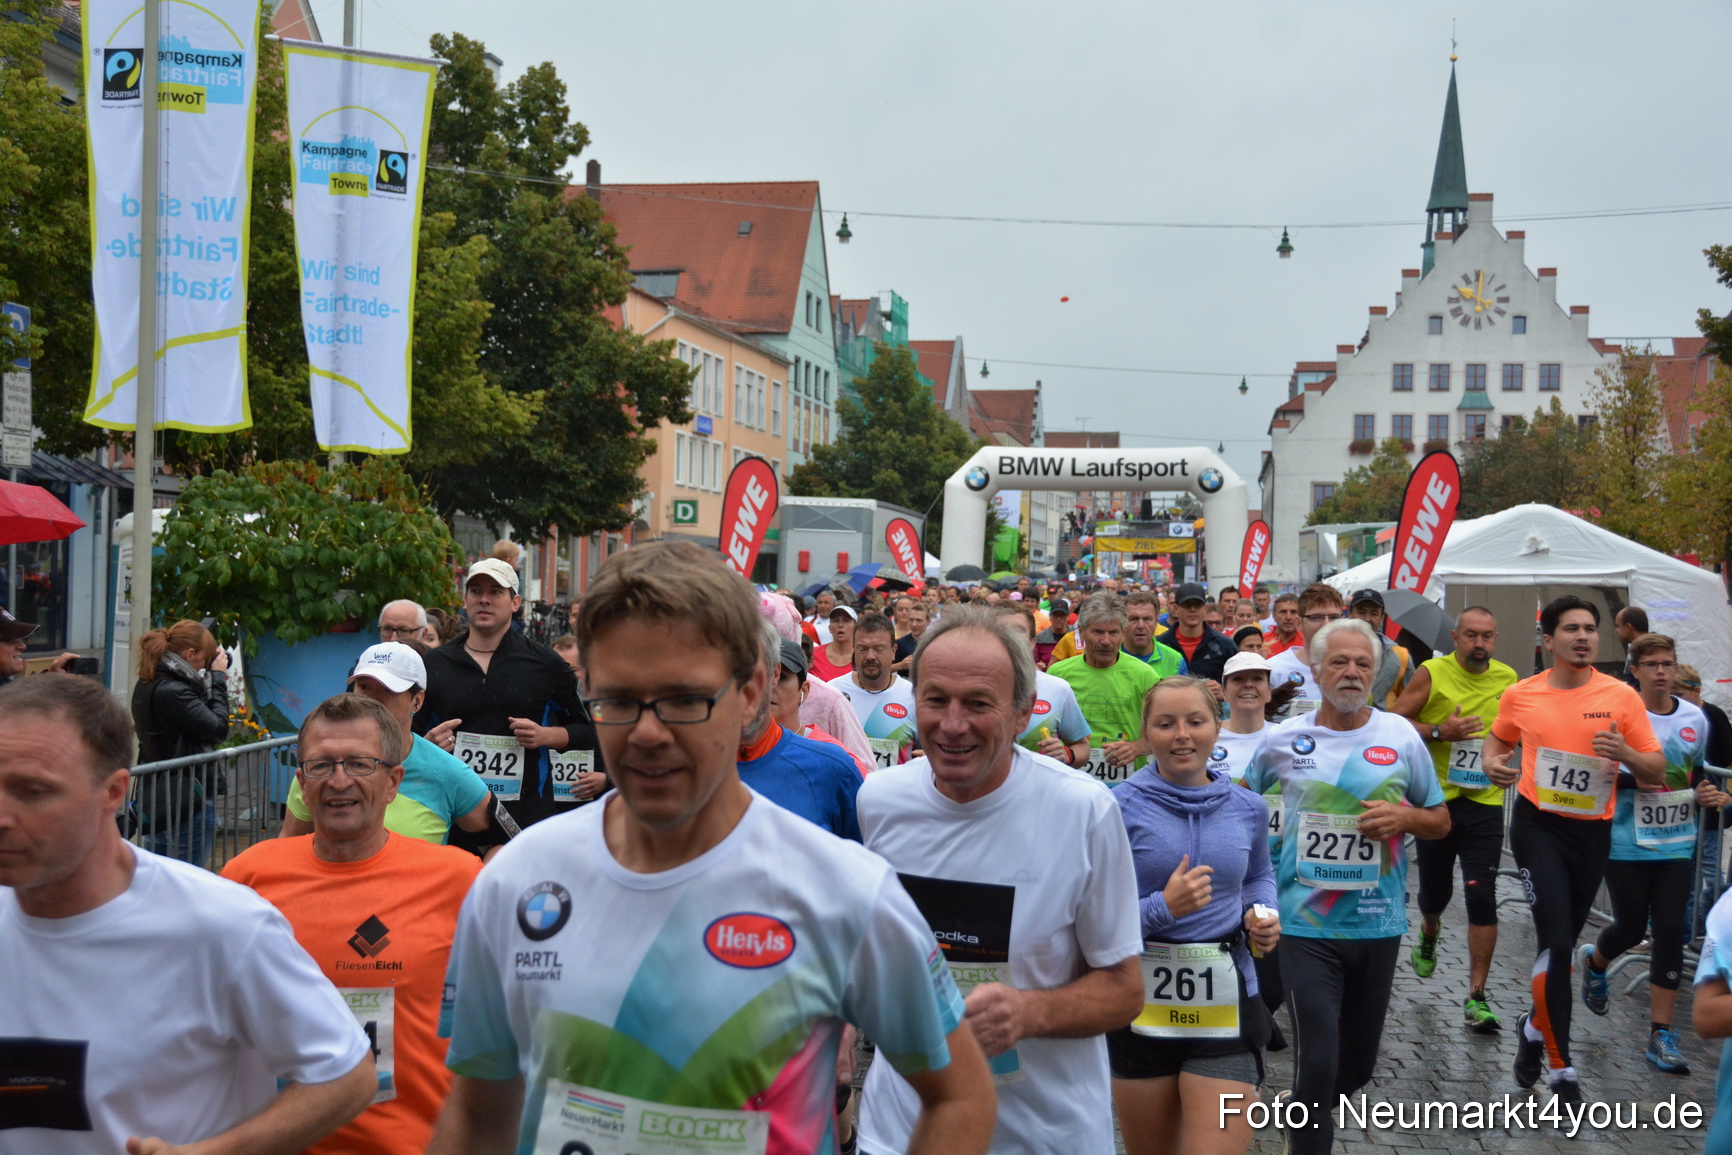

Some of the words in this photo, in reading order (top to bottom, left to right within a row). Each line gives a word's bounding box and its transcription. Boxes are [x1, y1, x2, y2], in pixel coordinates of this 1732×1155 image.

[302, 142, 368, 158] Kampagne
[302, 154, 373, 175] Fairtrade
[331, 178, 368, 191] Towns
[301, 259, 338, 280] Wir
[343, 262, 381, 285] sind
[998, 456, 1064, 477] BMW
[1071, 457, 1189, 481] Laufsport
[677, 503, 694, 520] D
[1395, 472, 1452, 589] REWE
[1134, 540, 1157, 550] ZIEL
[1242, 529, 1266, 589] REWE
[886, 705, 905, 715] Hervis
[1033, 703, 1049, 711] ervis
[1583, 711, 1611, 719] THULE
[461, 748, 518, 776] 2342
[1367, 750, 1396, 761] Hervis
[1548, 765, 1590, 792] 143
[1552, 793, 1575, 805] Sven
[1641, 803, 1690, 825] 3079
[1305, 831, 1374, 861] 2275
[1314, 866, 1363, 880] Raimund
[717, 924, 786, 955] Hervis
[933, 931, 978, 944] odka
[515, 952, 563, 968] PARTL
[1177, 947, 1224, 958] BOCK
[335, 961, 403, 971] FliesenEichl
[515, 969, 561, 981] Neumarkt
[1153, 967, 1214, 1001] 261
[1169, 1010, 1200, 1024] Resi
[560, 1107, 626, 1133] NeuerMarkt
[637, 1110, 748, 1142] BOCK
